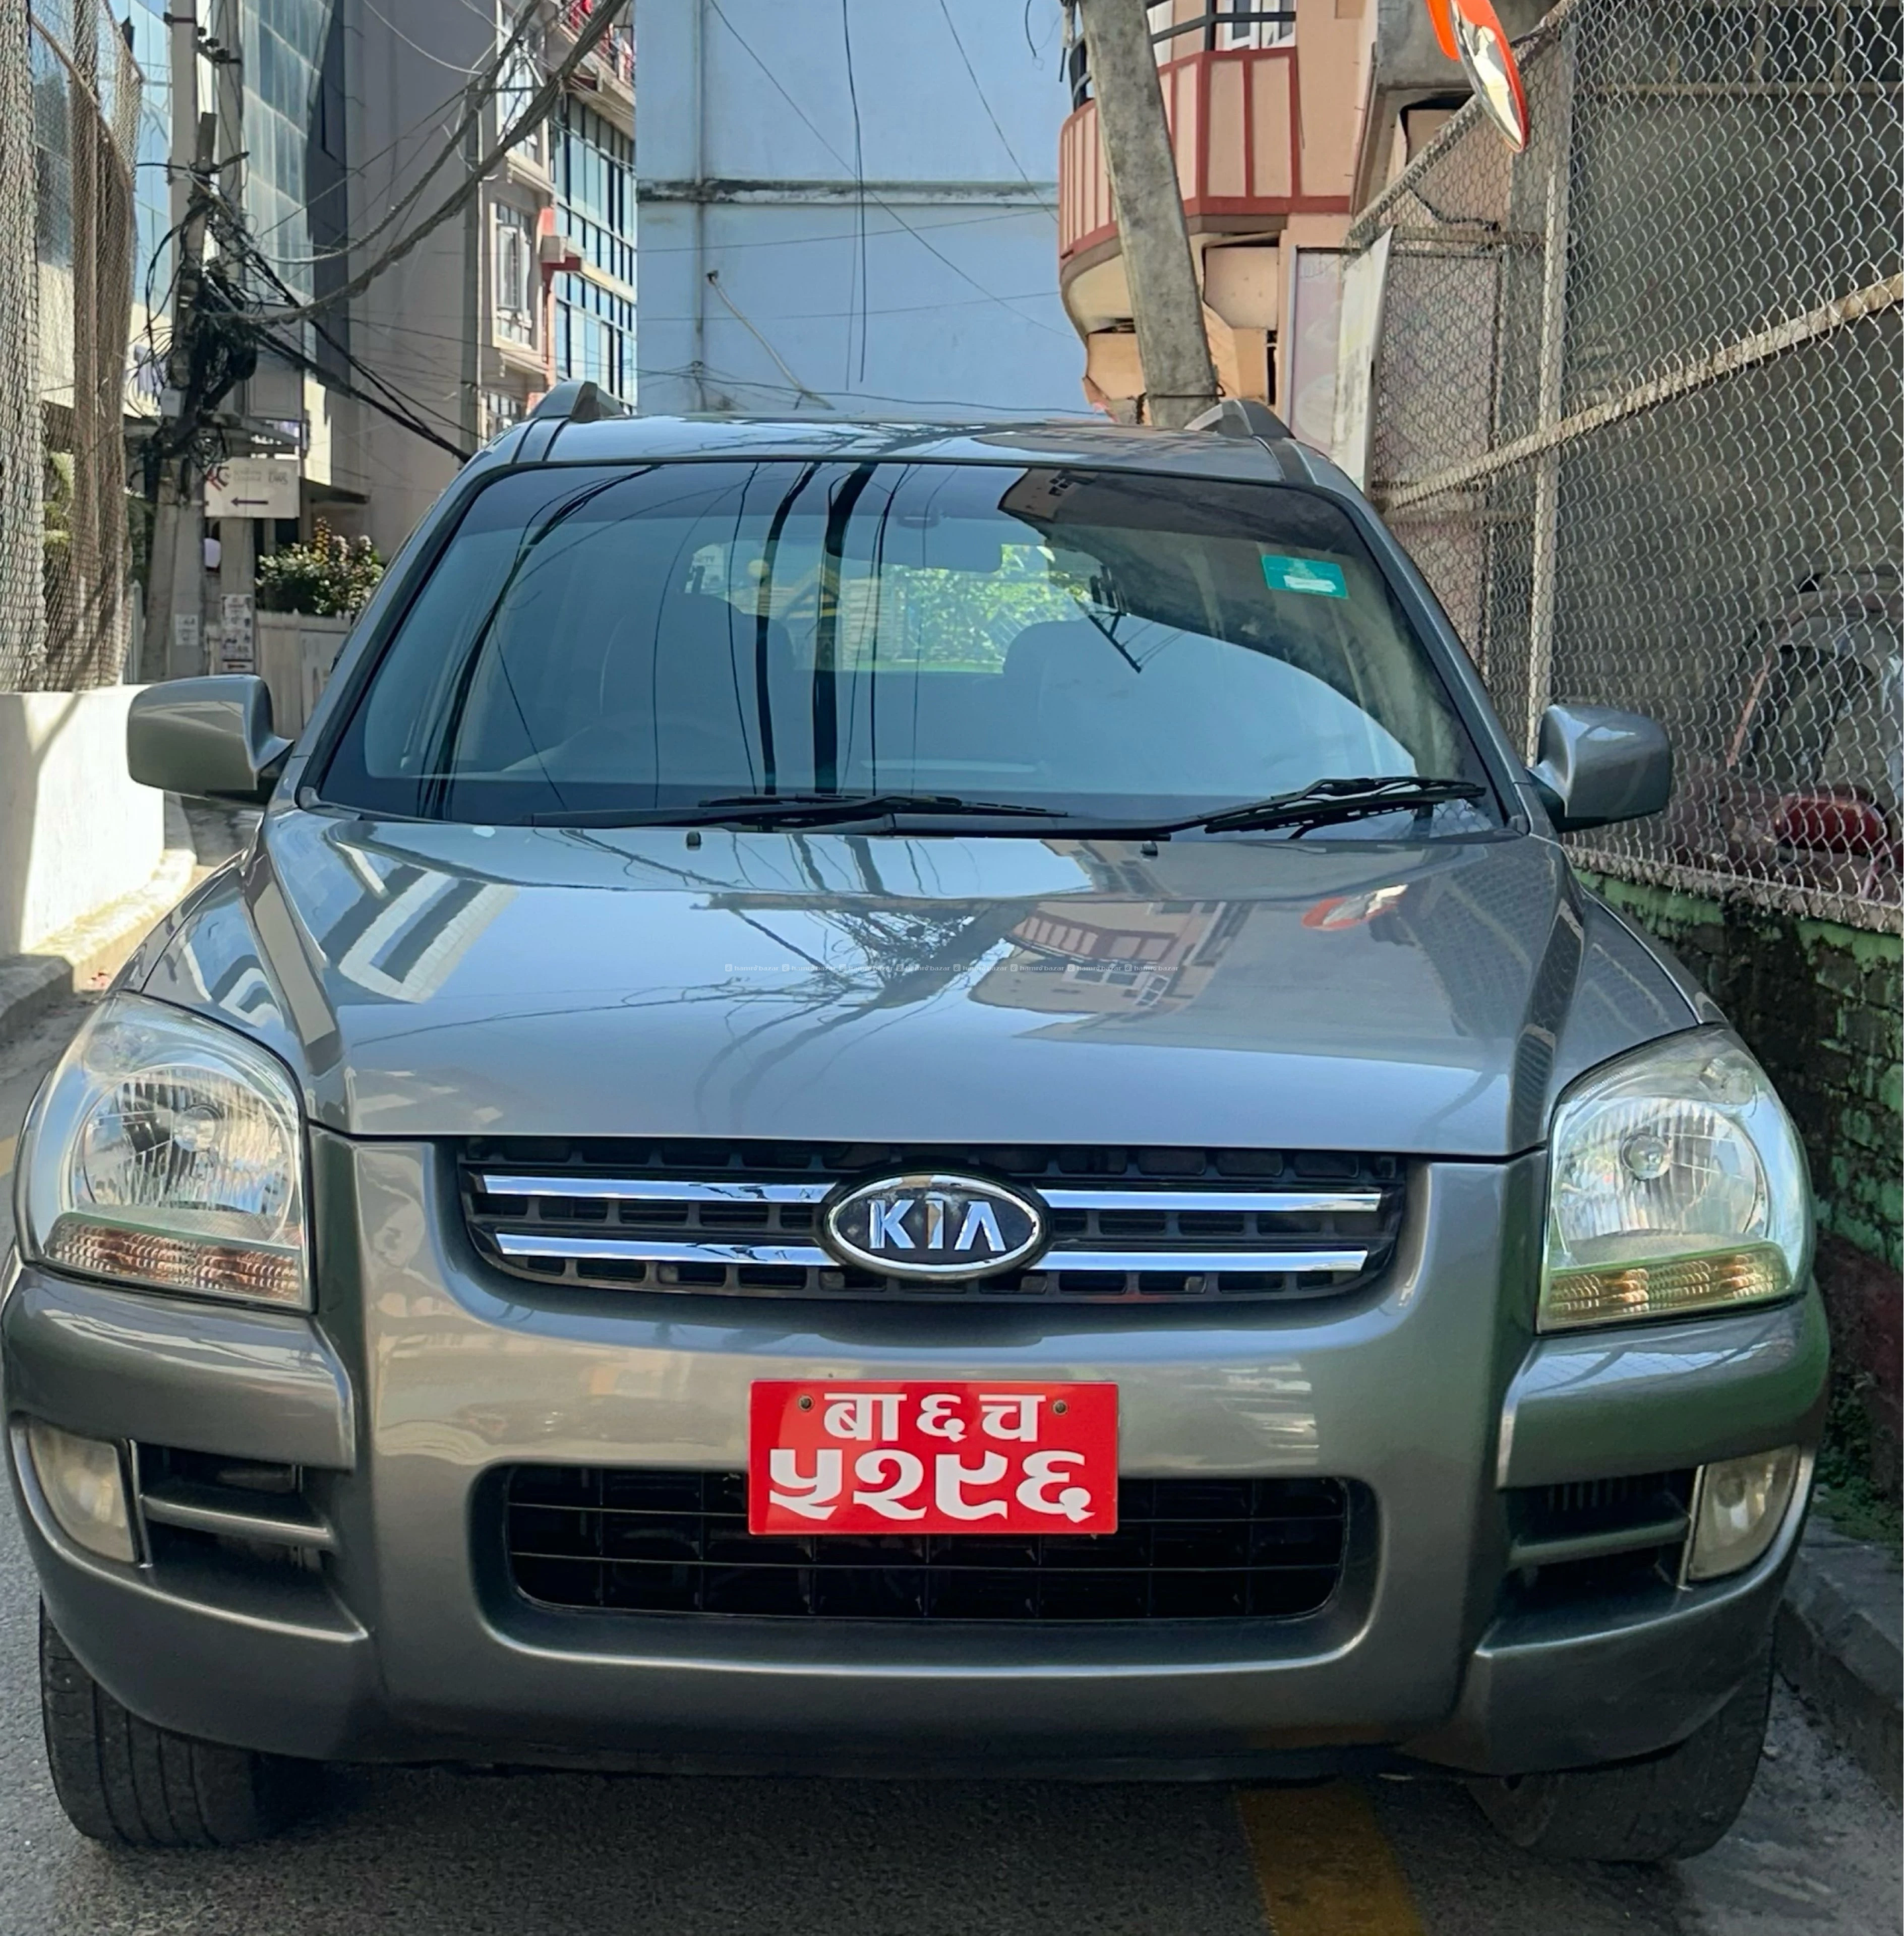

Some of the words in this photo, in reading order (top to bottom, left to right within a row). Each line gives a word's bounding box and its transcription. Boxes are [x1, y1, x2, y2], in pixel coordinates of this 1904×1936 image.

[869, 1198, 1006, 1252] KIA
[824, 1393, 907, 1441] बा
[916, 1394, 967, 1441] ६
[979, 1395, 1046, 1442] च
